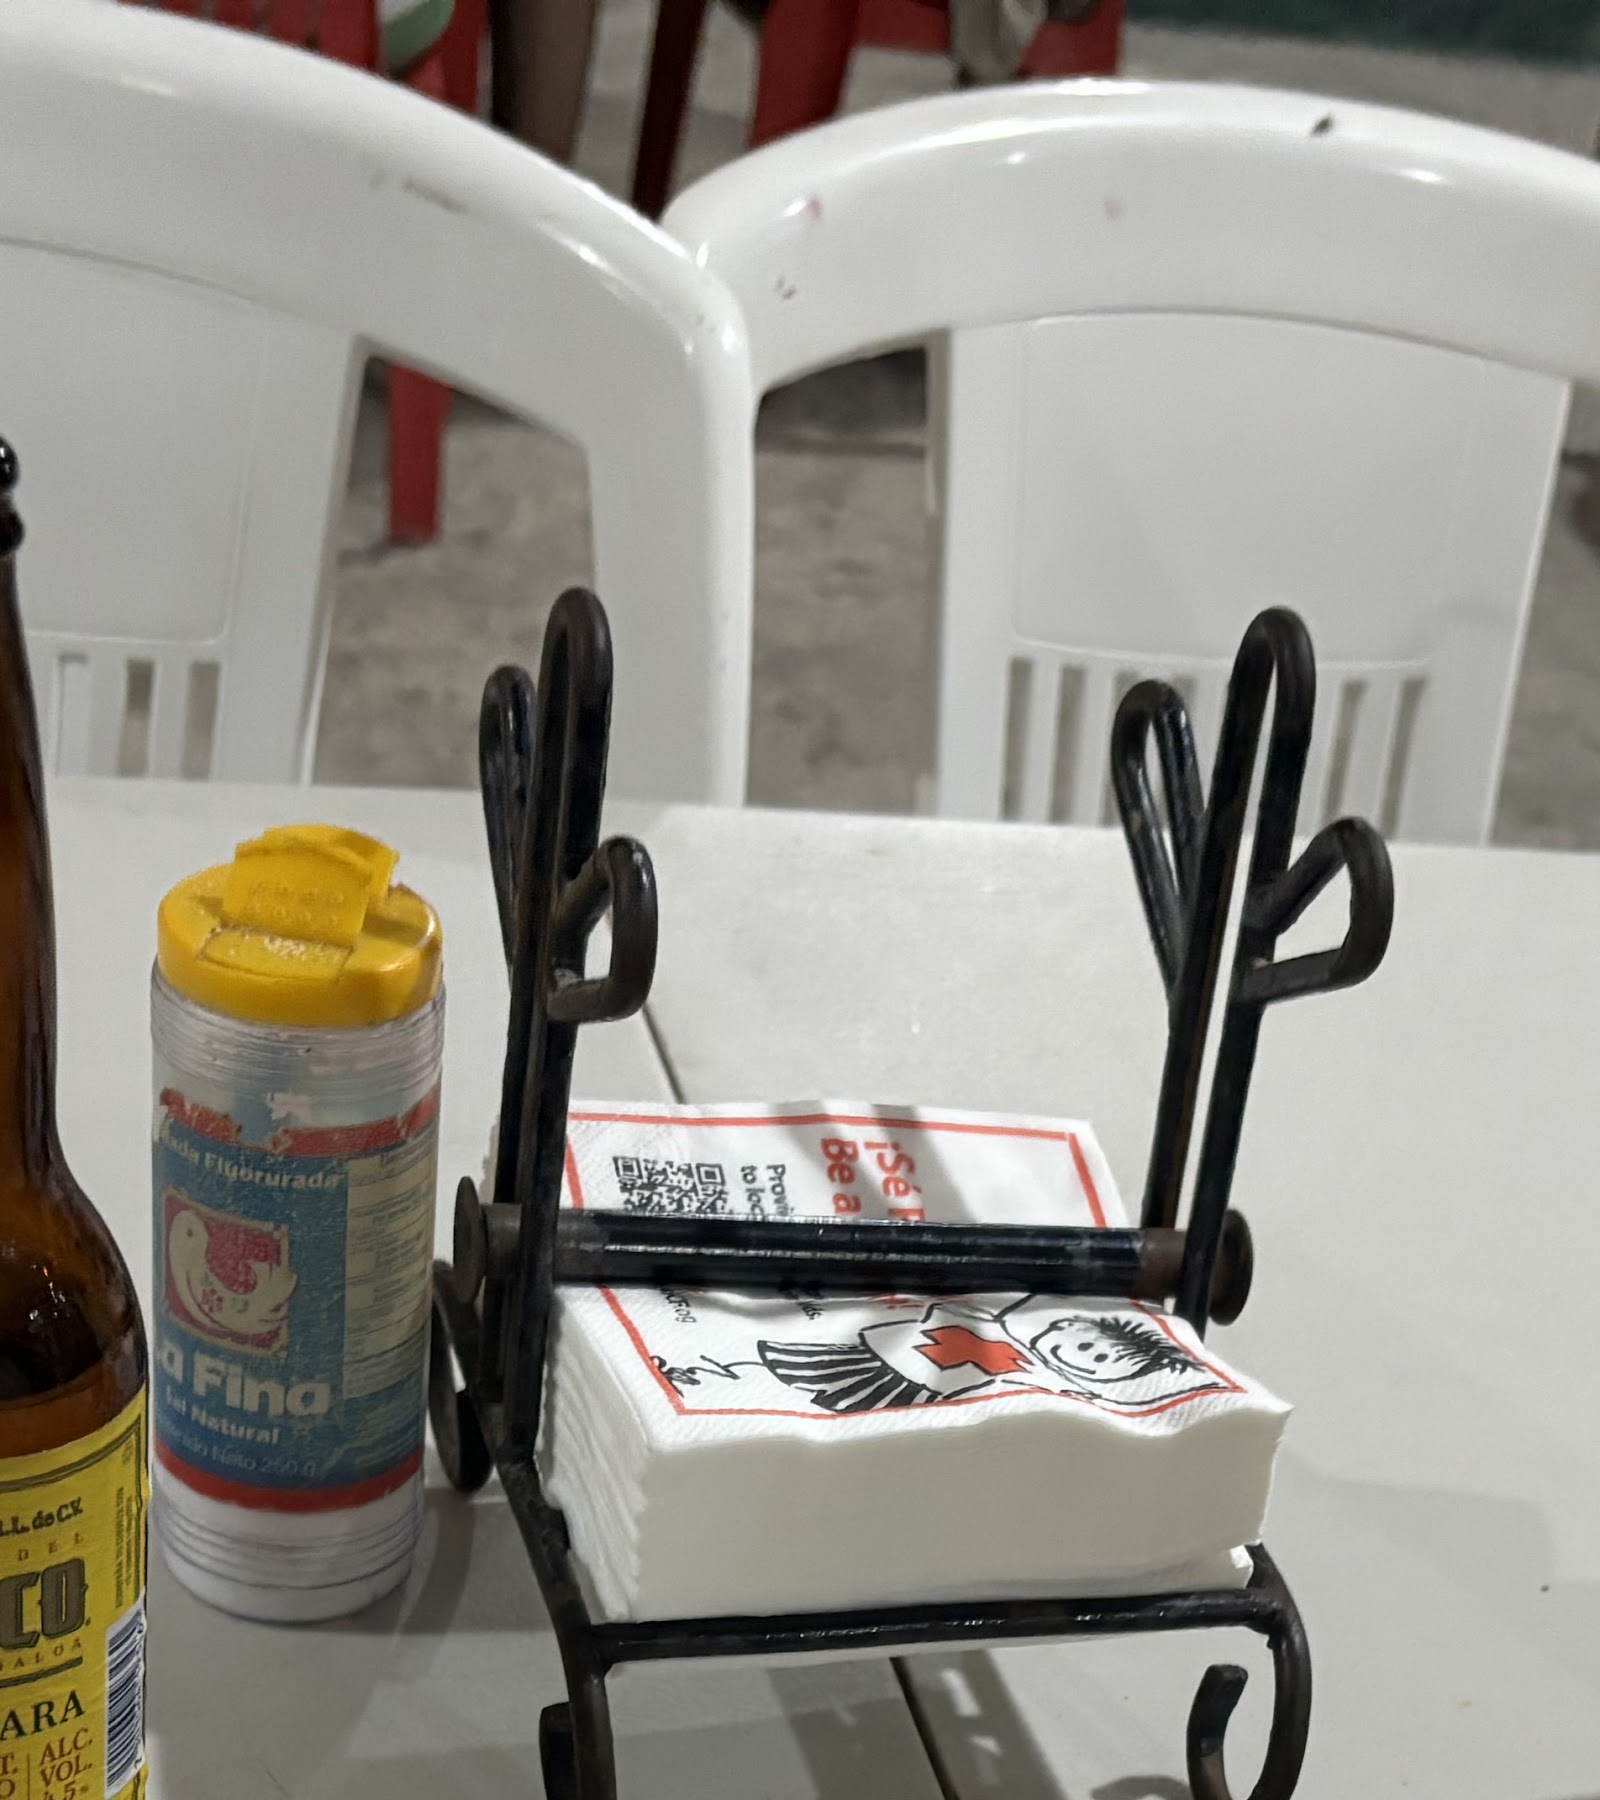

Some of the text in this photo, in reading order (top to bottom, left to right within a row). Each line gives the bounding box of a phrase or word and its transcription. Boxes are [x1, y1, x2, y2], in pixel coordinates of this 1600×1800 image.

[741, 1165, 757, 1184] to
[821, 1138, 861, 1215] Be a
[193, 1351, 332, 1418] Fina
[191, 1405, 280, 1446] Natural
[40, 1727, 93, 1766] ALC.
[40, 1754, 93, 1788] VOL.
